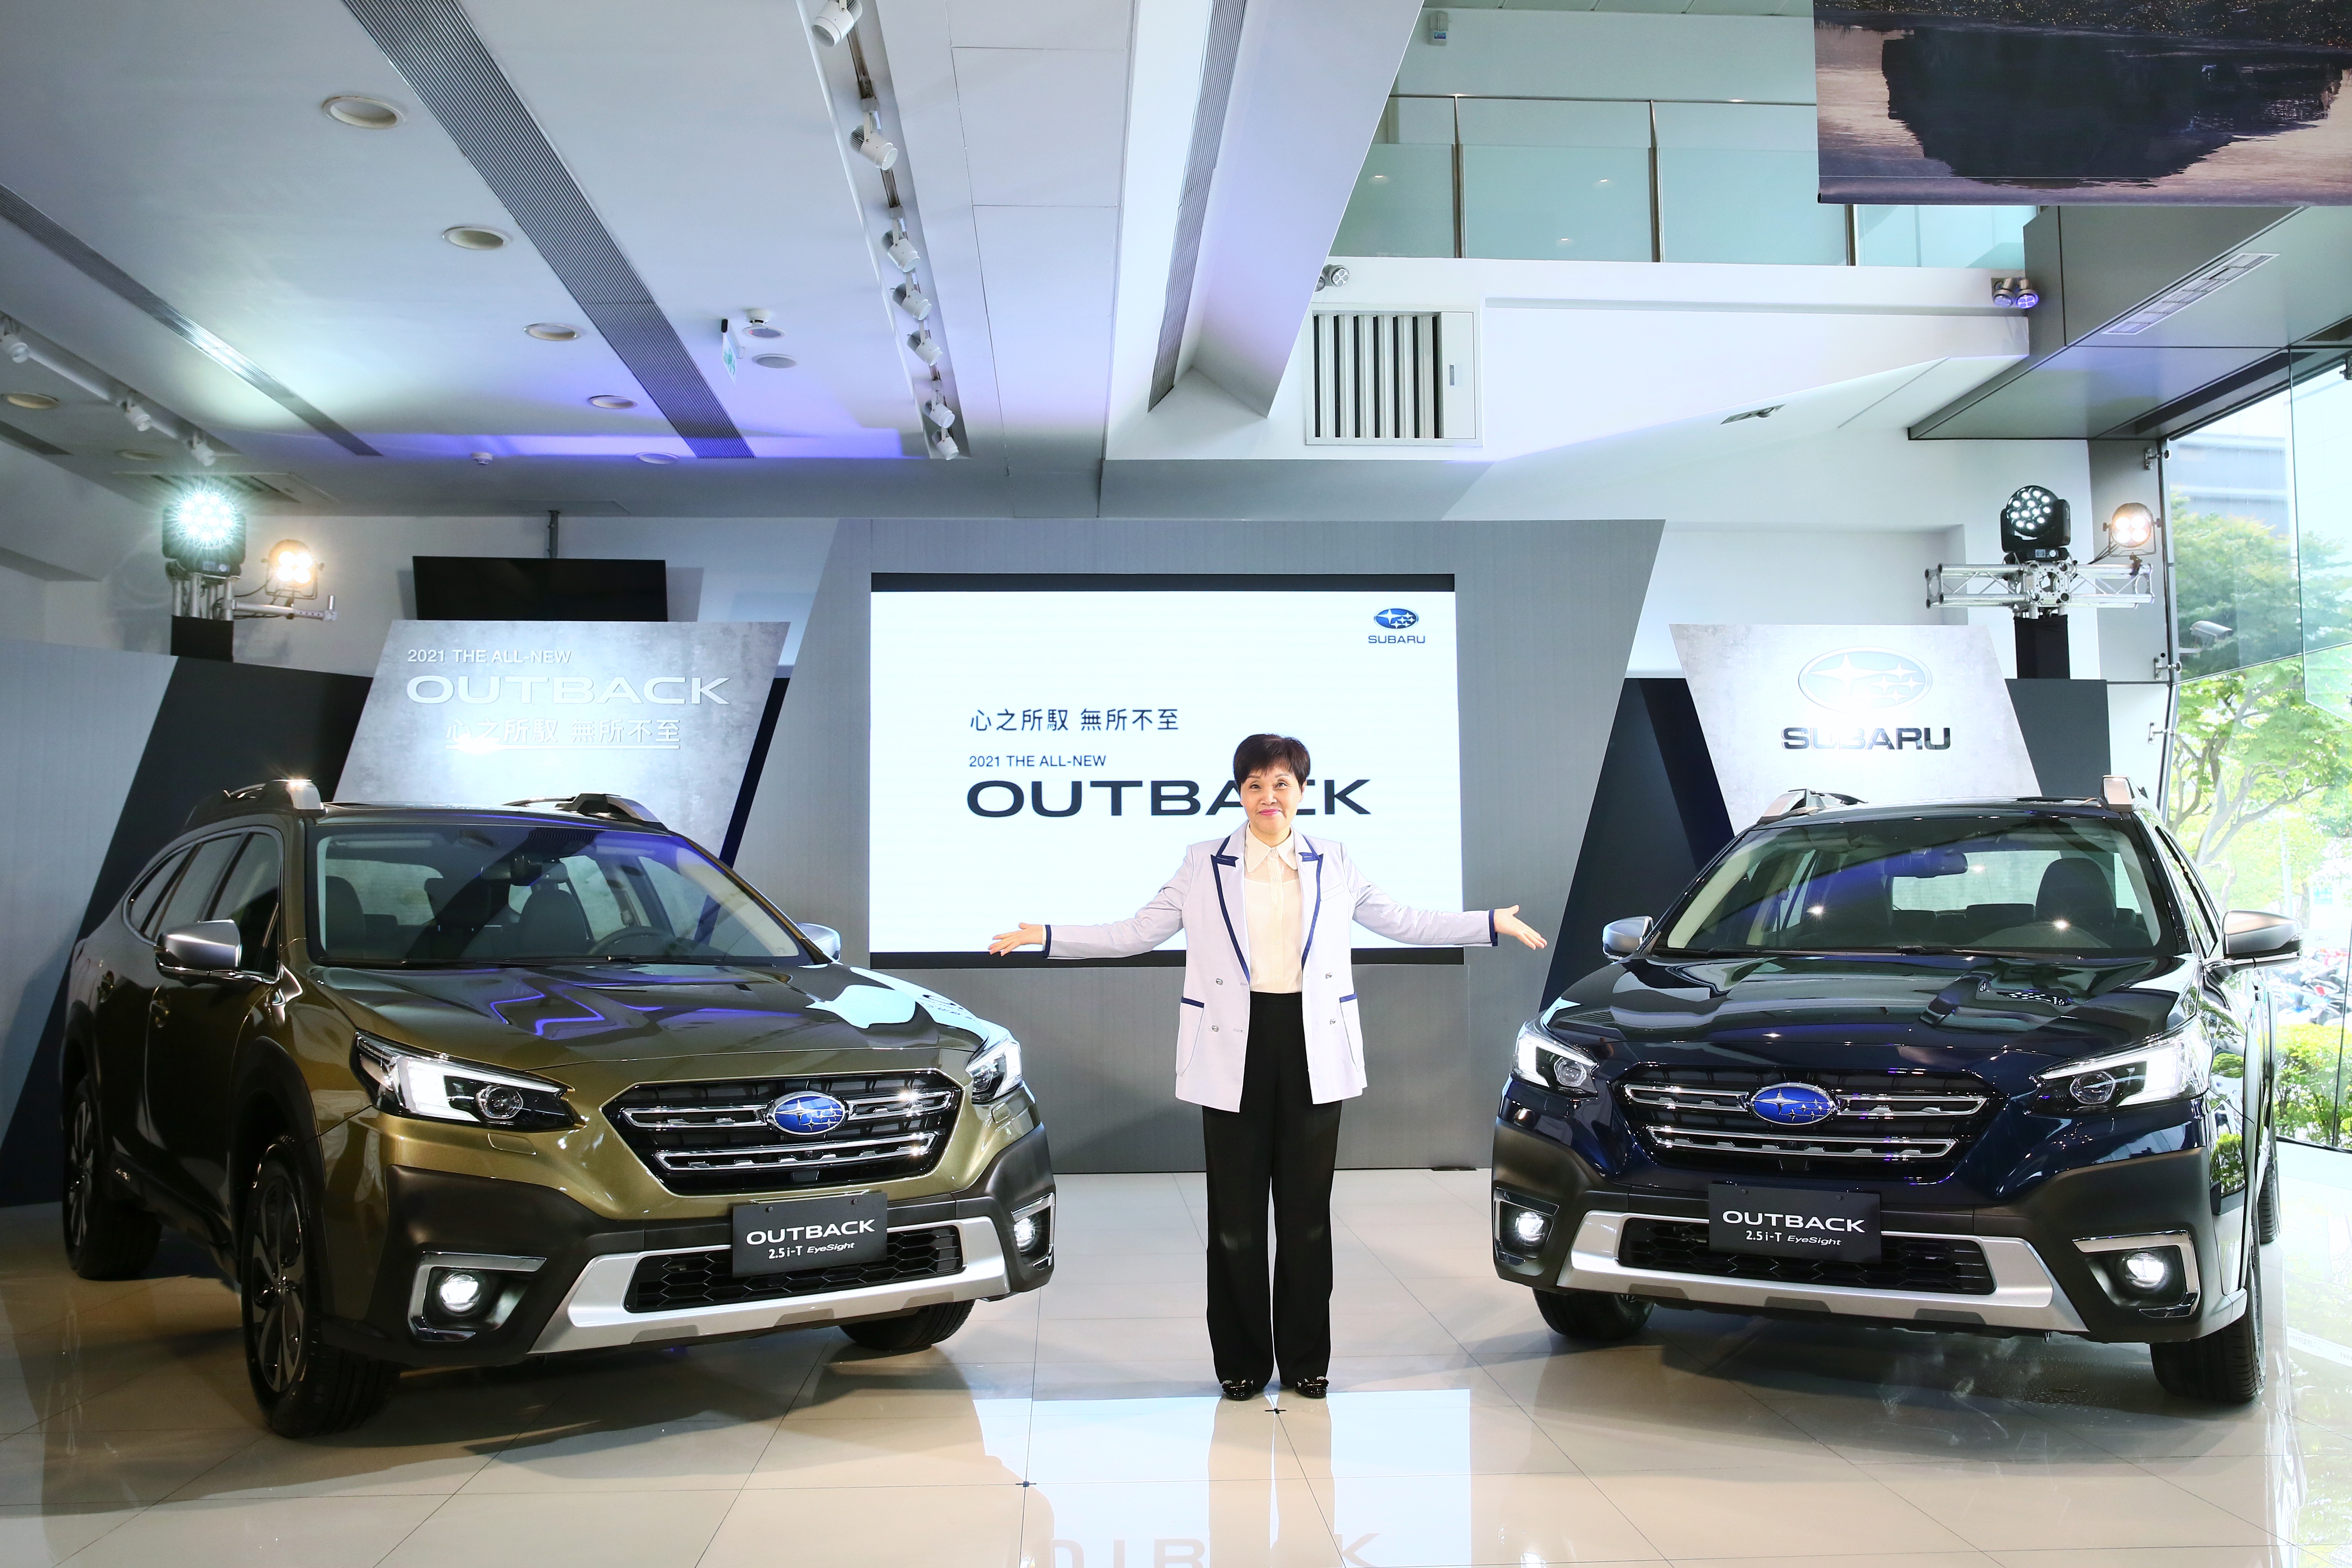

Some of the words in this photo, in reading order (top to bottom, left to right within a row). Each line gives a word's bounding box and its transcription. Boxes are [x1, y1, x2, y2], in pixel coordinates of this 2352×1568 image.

[1368, 635, 1425, 644] SUBARU
[407, 649, 445, 663] 2021
[452, 649, 488, 663] THE
[491, 650, 572, 664] ALL-NEW
[406, 675, 730, 704] OUTBACK
[570, 718, 681, 743] 無所不至
[970, 708, 1068, 731] 心之所馭
[1080, 708, 1178, 731] 無所不至
[1781, 727, 1951, 751] SUBARU
[969, 755, 999, 767] 2021
[1006, 755, 1035, 767] THE
[1039, 755, 1106, 766] ALL-NEW
[746, 1219, 875, 1245] OUTBACK
[1722, 1211, 1865, 1233] OUTBACK
[807, 1242, 855, 1254] EyeSight
[1787, 1235, 1841, 1245] EyeSight
